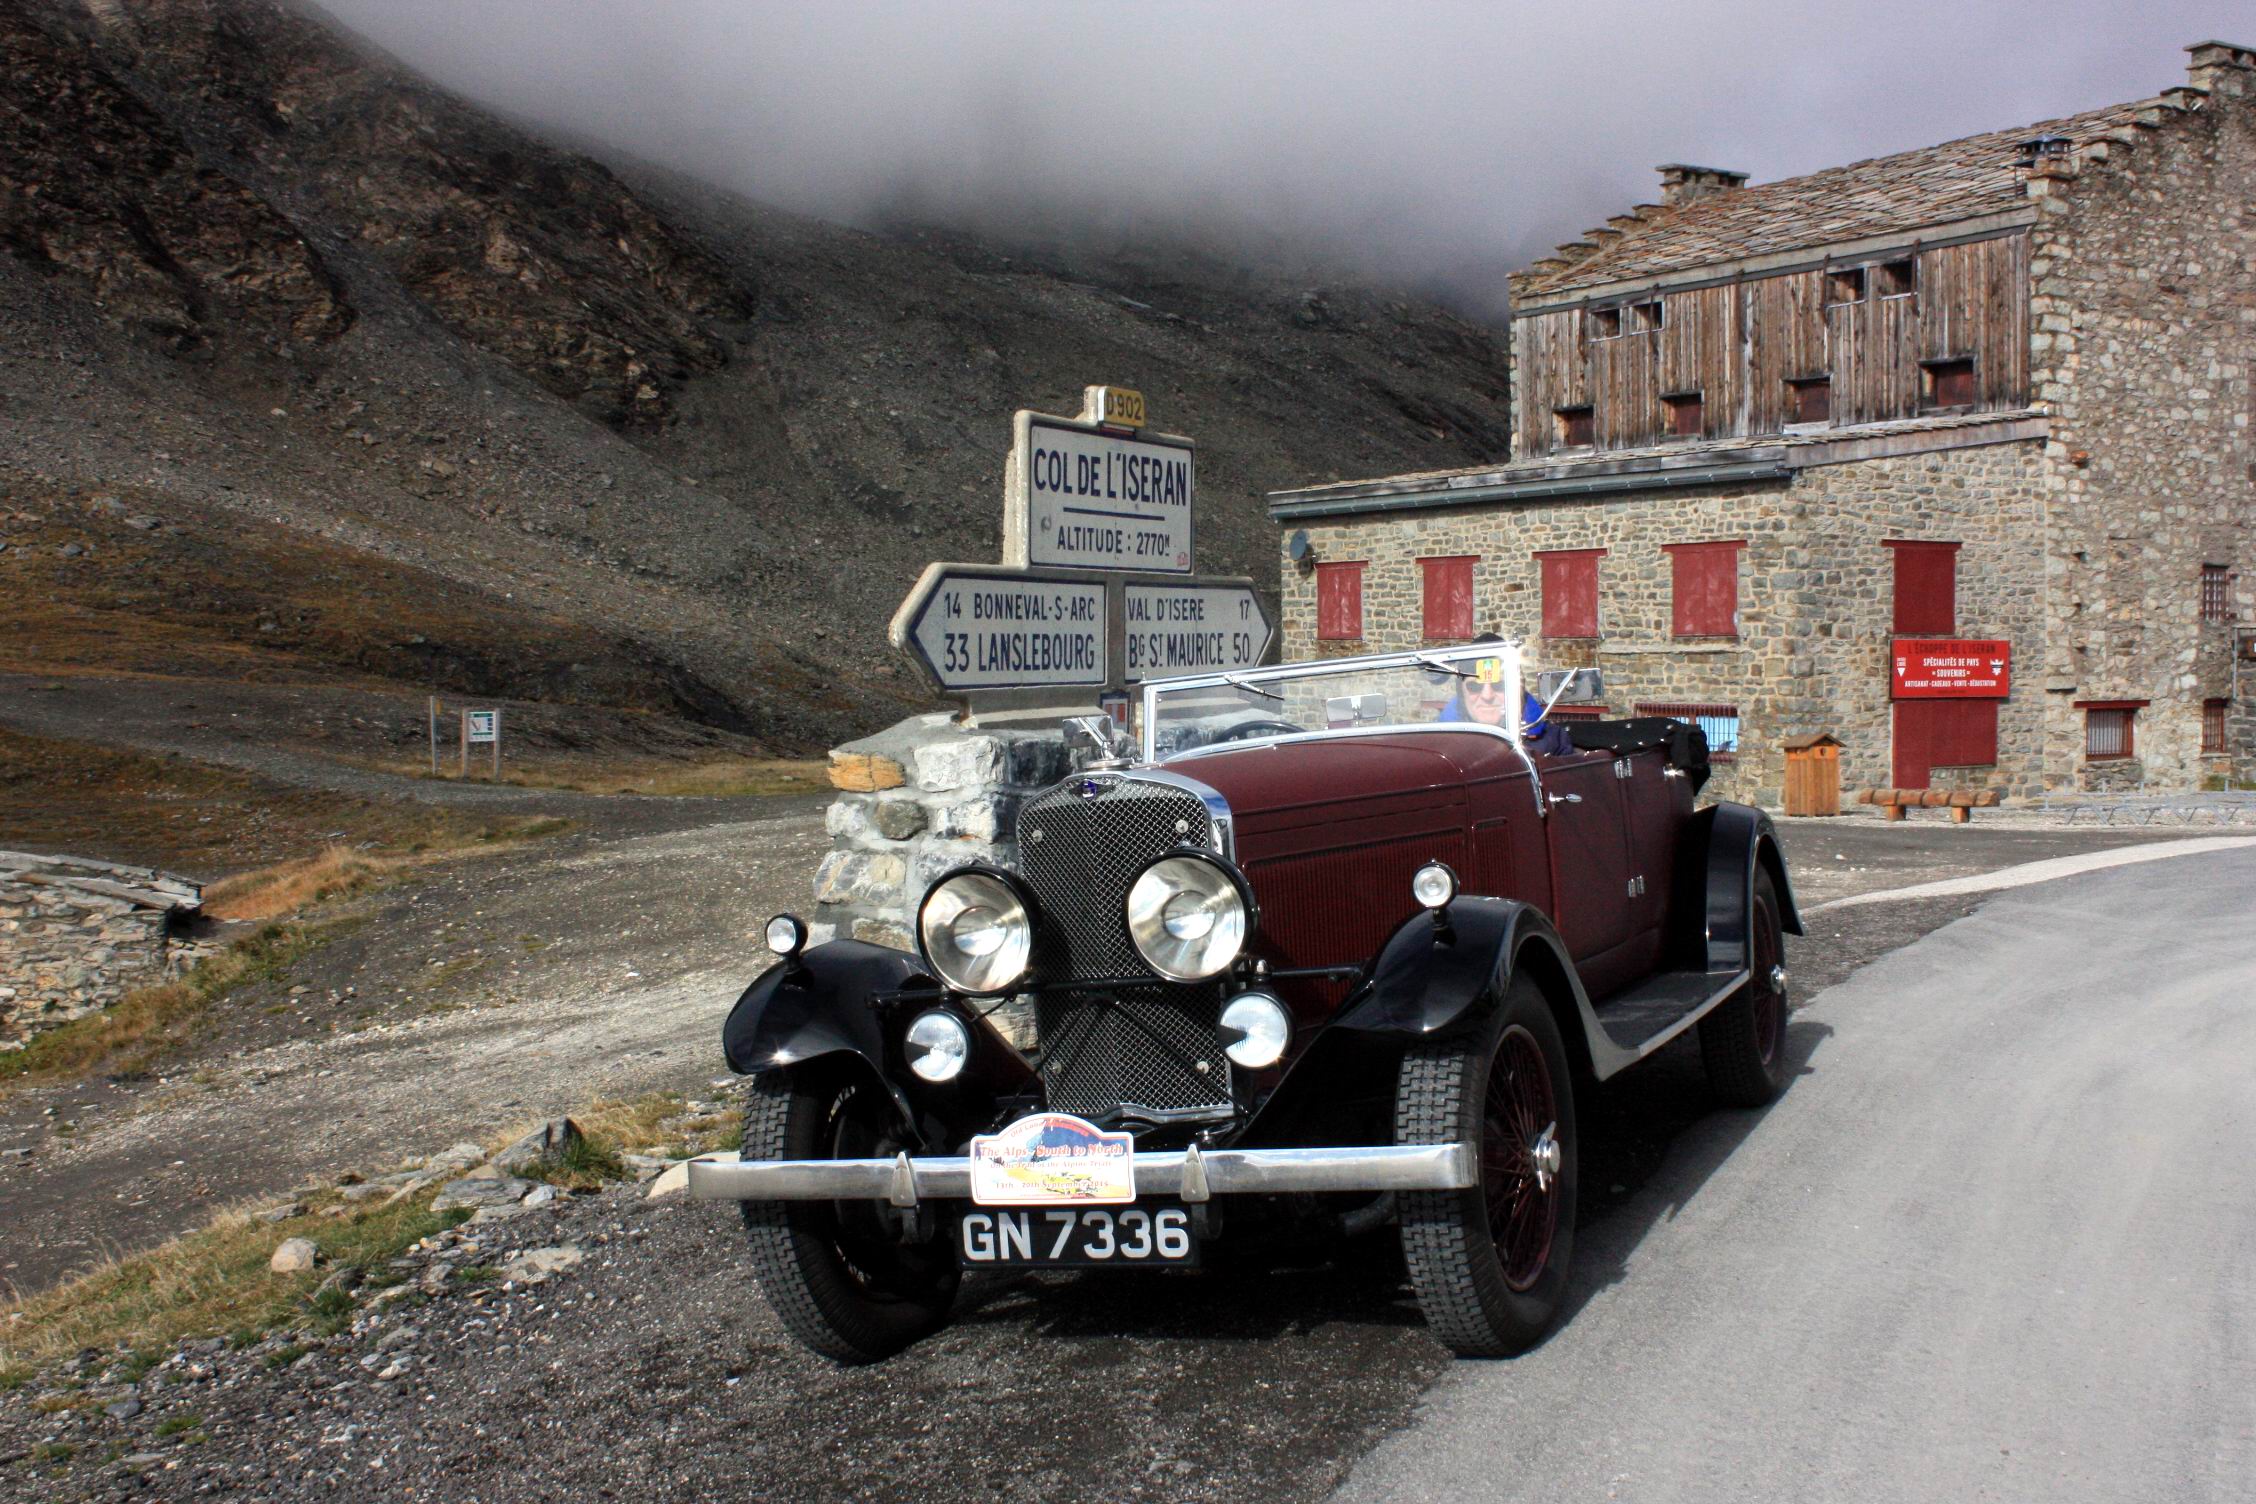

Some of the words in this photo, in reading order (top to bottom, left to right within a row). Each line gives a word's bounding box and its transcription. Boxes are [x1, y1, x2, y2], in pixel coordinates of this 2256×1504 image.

[1033, 448, 1073, 494] COL
[1077, 454, 1101, 497] DE
[1107, 451, 1186, 506] L'ISERAN
[1057, 525, 1123, 554] ALTITUDE
[944, 592, 962, 619] 14
[1127, 597, 1151, 621] VAL
[1157, 597, 1205, 621] D'ISERE
[1239, 599, 1250, 621] 17
[944, 633, 970, 673] 33
[978, 632, 1095, 672] LANSLEBOURG
[1167, 632, 1225, 667] MAURICE
[1233, 632, 1250, 664] 50
[1958, 658, 1965, 667] DE
[1966, 658, 1980, 667] PAYS
[1936, 669, 1967, 678] SOUVENIRS
[981, 1146, 1000, 1157] The
[1003, 1146, 1028, 1159] Alps
[1036, 1144, 1071, 1157] South
[1074, 1146, 1087, 1157] to
[1087, 1143, 1124, 1156] North
[962, 1212, 1032, 1260] GN
[1045, 1208, 1190, 1260] 7336
